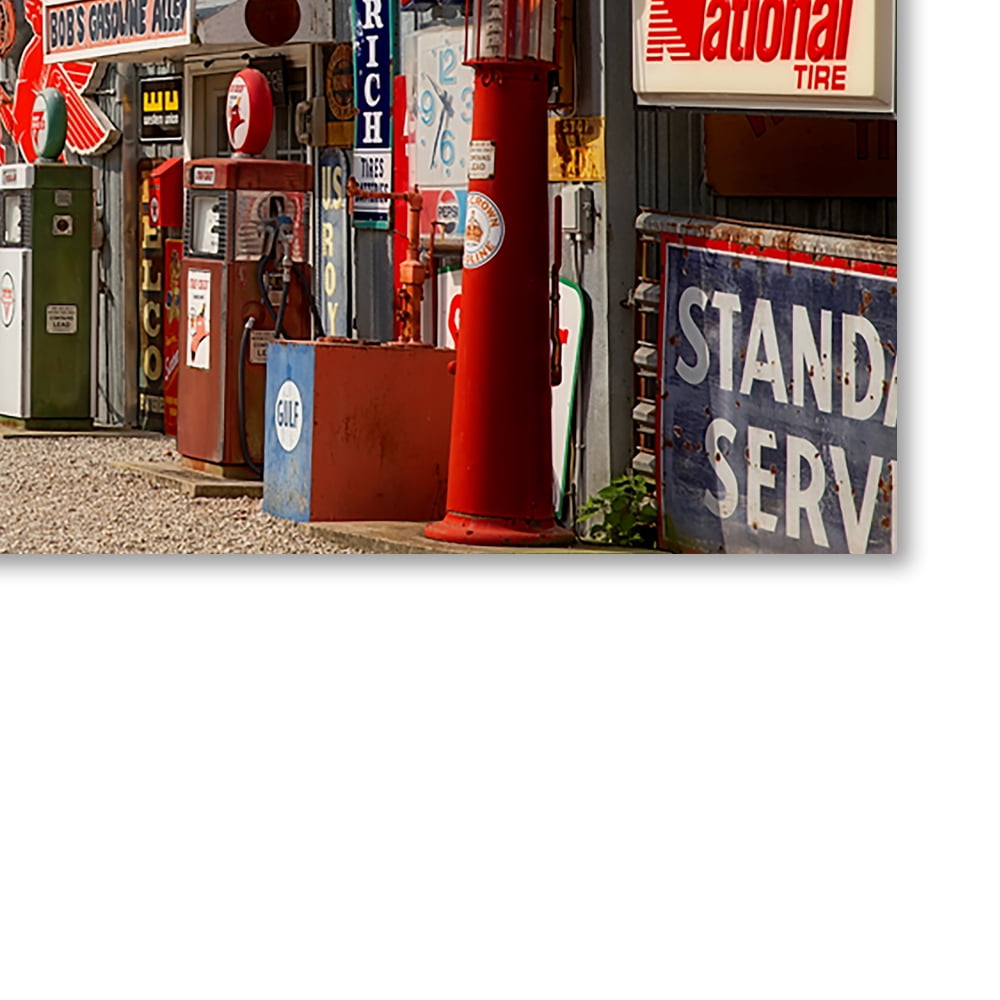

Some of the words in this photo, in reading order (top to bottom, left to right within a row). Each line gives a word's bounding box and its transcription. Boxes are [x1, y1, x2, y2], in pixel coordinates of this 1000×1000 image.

[50, 1, 85, 49] BOB'S
[438, 48, 457, 84] 12
[793, 65, 848, 91] TIRE
[420, 89, 435, 126] 9
[439, 129, 455, 166] 6
[360, 157, 384, 179] TIRES
[321, 166, 343, 211] U.S.
[437, 204, 459, 218] PEPSI
[464, 240, 495, 265] OLINE
[277, 400, 300, 428] GULF
